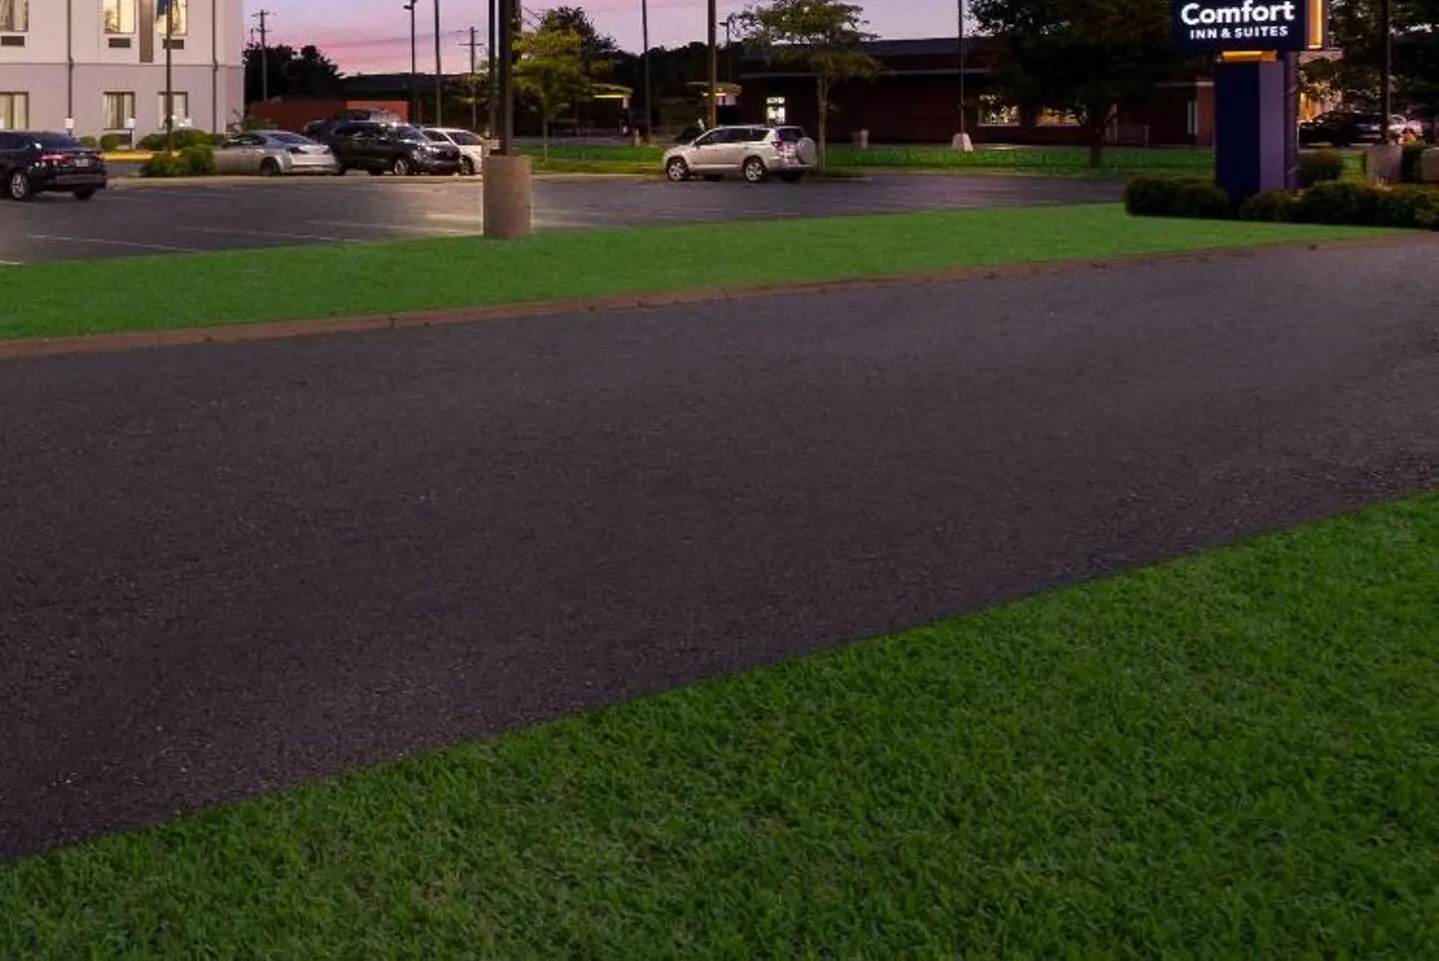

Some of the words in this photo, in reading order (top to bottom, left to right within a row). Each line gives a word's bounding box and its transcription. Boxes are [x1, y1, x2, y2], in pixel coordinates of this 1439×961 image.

[1190, 29, 1218, 40] INN
[1221, 28, 1232, 39] &
[1234, 25, 1289, 39] SUITES
